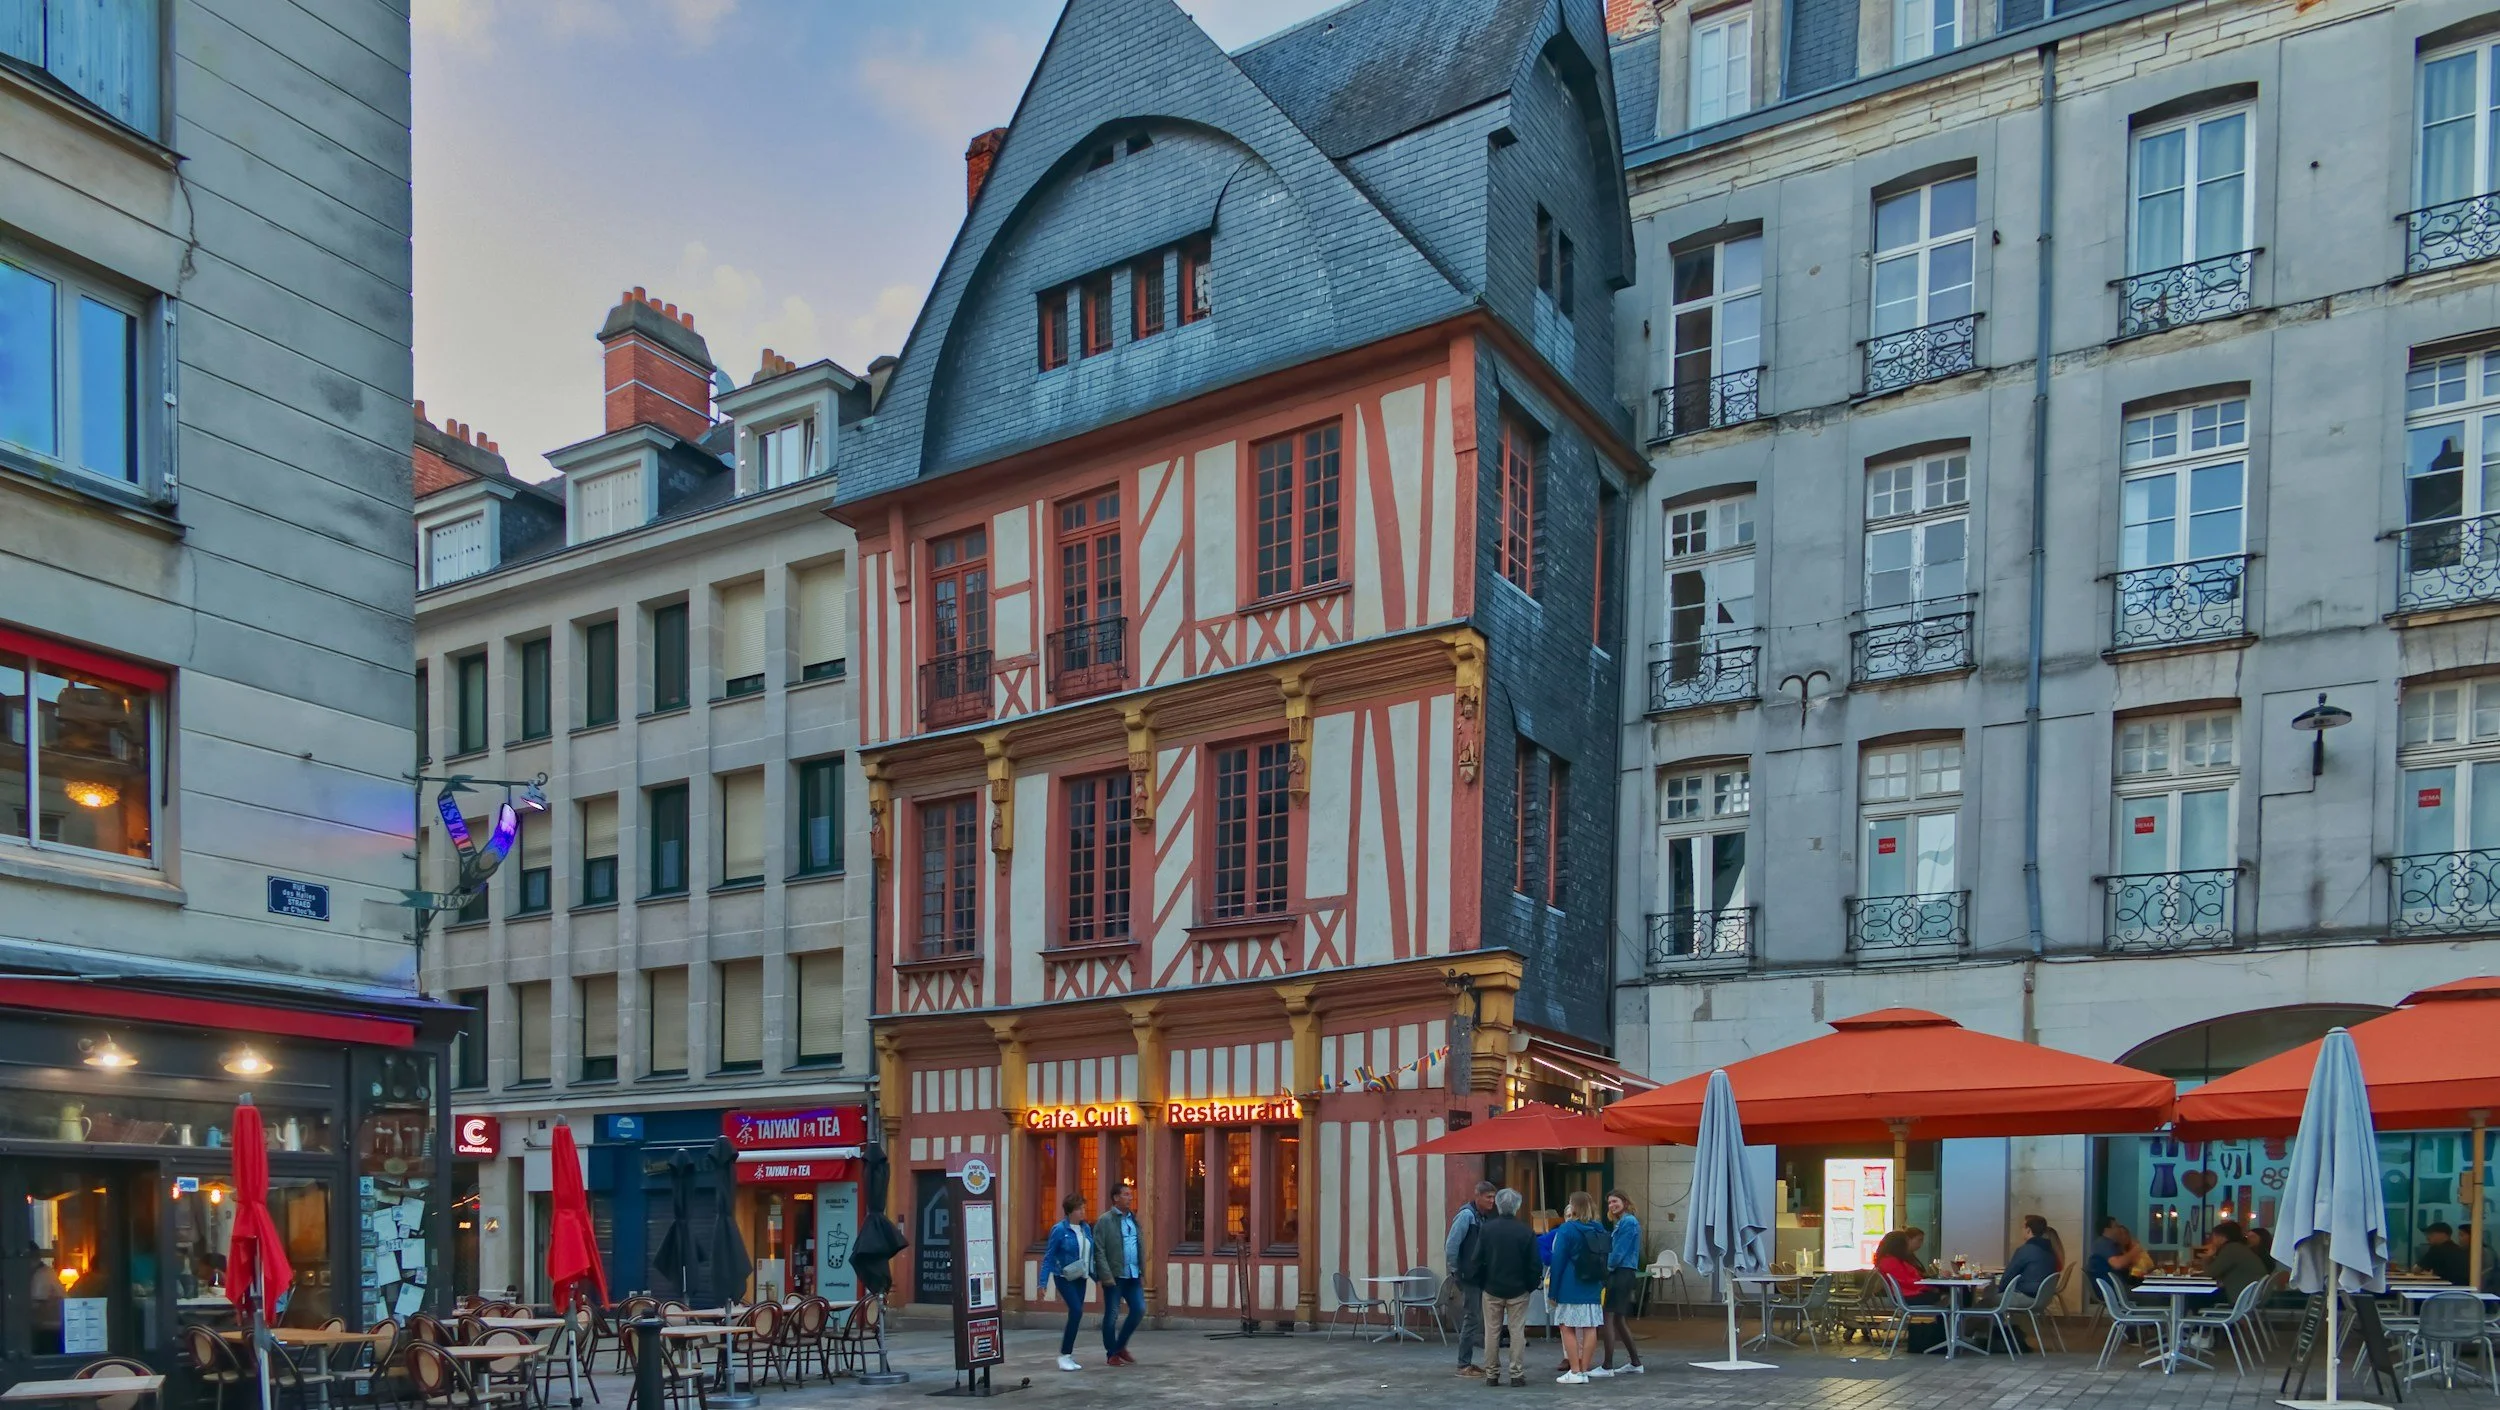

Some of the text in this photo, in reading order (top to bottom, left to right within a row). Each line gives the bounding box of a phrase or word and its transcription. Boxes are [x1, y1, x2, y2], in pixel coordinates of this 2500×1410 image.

[282, 889, 294, 897] des
[292, 883, 306, 892] RUE
[288, 898, 311, 909] STRAED
[1167, 1099, 1295, 1124] Restaurant
[756, 1118, 800, 1140] TAIYAKI
[817, 1116, 841, 1137] TEA
[765, 1165, 789, 1177] TAIYAKI
[798, 1164, 811, 1177] TEA
